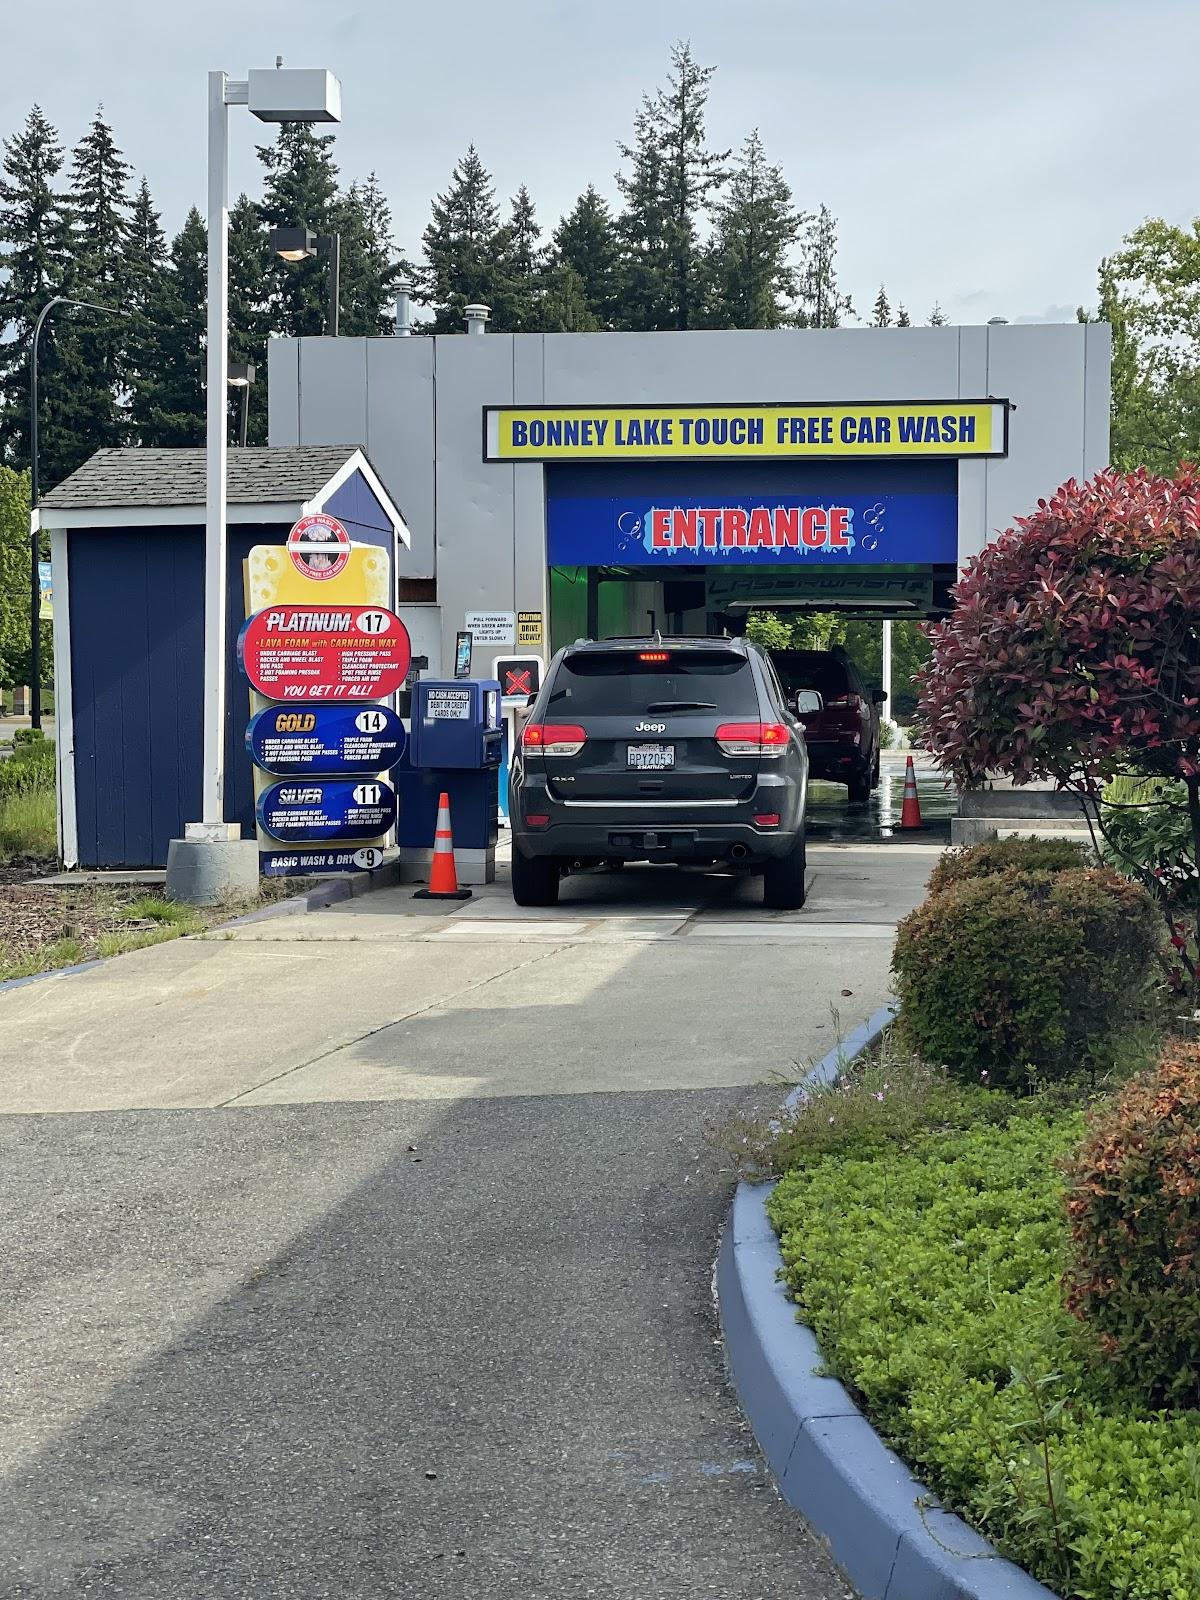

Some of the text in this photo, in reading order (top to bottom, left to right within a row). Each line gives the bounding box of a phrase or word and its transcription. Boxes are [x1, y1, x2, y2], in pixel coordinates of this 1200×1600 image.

[512, 415, 976, 446] BONNEY LAKE TOUCH FREE CAR WASH
[316, 518, 334, 527] WASH
[652, 508, 850, 548] ENTRANCE
[296, 559, 309, 574] TOUCH
[333, 559, 344, 573] WASH
[266, 612, 382, 632] PLATINUM 17
[260, 638, 398, 648] LAVA FOAM with CARNAUBA WAX
[520, 633, 540, 641] SLOWLY
[284, 685, 372, 696] YOU GET IT ALL!
[428, 691, 468, 700] NO CASH ACCEPTED
[276, 714, 380, 732] GOLD 14
[635, 722, 666, 733] Jeep
[630, 754, 672, 766] BPY2053
[279, 786, 376, 804] SILVER 11
[271, 856, 298, 868] BASIC
[300, 856, 325, 866] WASH
[328, 855, 334, 864] &
[336, 854, 354, 864] DRY
